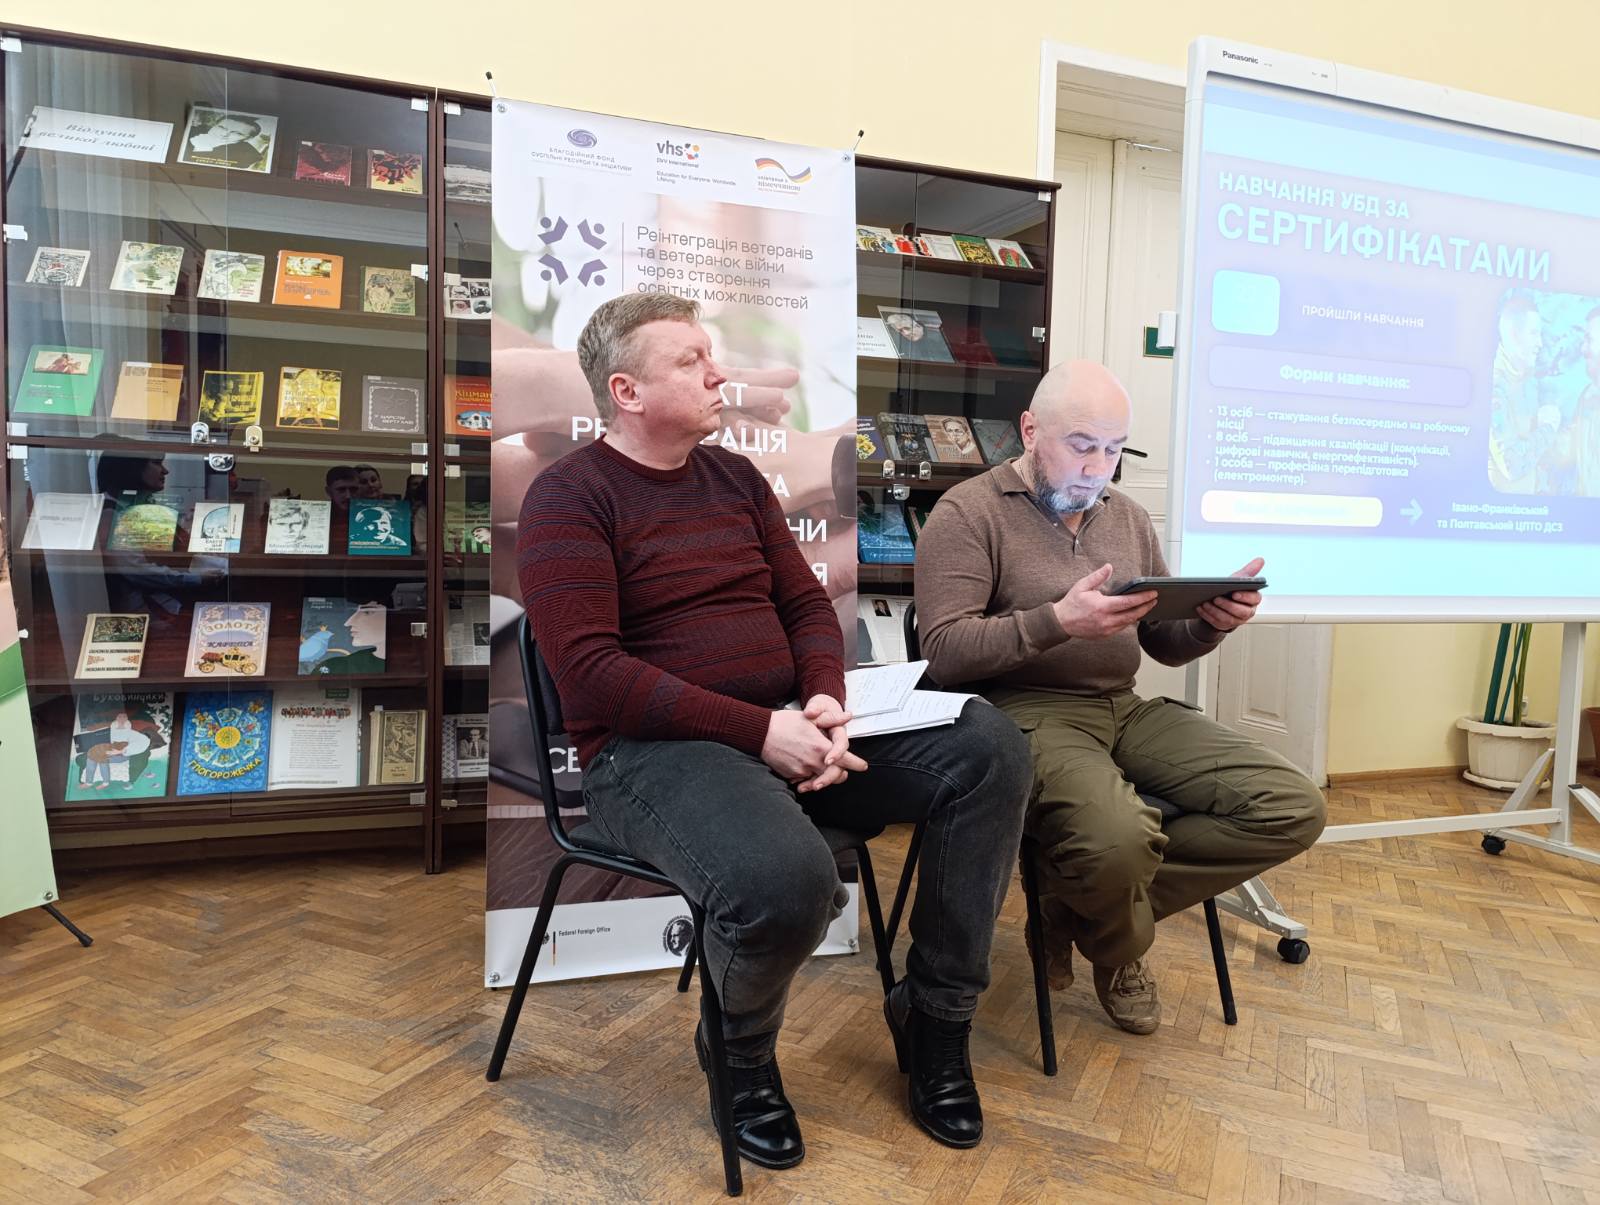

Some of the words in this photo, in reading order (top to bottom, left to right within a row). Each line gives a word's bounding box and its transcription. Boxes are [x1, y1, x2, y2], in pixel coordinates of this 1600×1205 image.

[1222, 50, 1259, 64] Panasonic
[656, 140, 684, 156] vhs
[1219, 172, 1335, 207] НАВЧАННЯ
[1341, 188, 1380, 218] УБД
[1385, 198, 1411, 220] ЗА
[637, 226, 738, 254] Реінтеграція
[741, 240, 814, 260] ветеранів
[1216, 201, 1552, 283] СЕРТИФІКАТАМИ
[638, 246, 656, 259] та
[659, 249, 741, 269] ветеранок
[745, 257, 785, 273] війни
[637, 264, 684, 281] через
[688, 270, 770, 289] створення
[704, 289, 809, 310] можливостей
[1301, 303, 1362, 321] ПРОЙШЛИ
[1363, 312, 1425, 329] НАВЧАННЯ
[1279, 364, 1334, 387] Форми
[1337, 369, 1411, 390] навчання:
[1216, 405, 1228, 417] 13
[1230, 406, 1253, 418] осіб
[1267, 410, 1329, 424] стажування
[1332, 412, 1408, 430] безпосередньо
[1410, 421, 1422, 430] на
[1423, 421, 1471, 436] робочому
[1216, 418, 1245, 430] місці
[1225, 431, 1249, 443] осіб
[1215, 445, 1261, 459] цифрові
[1221, 457, 1254, 468] особа
[558, 929, 577, 937] Federal
[577, 928, 596, 936] Foreign
[596, 926, 611, 934] Office
